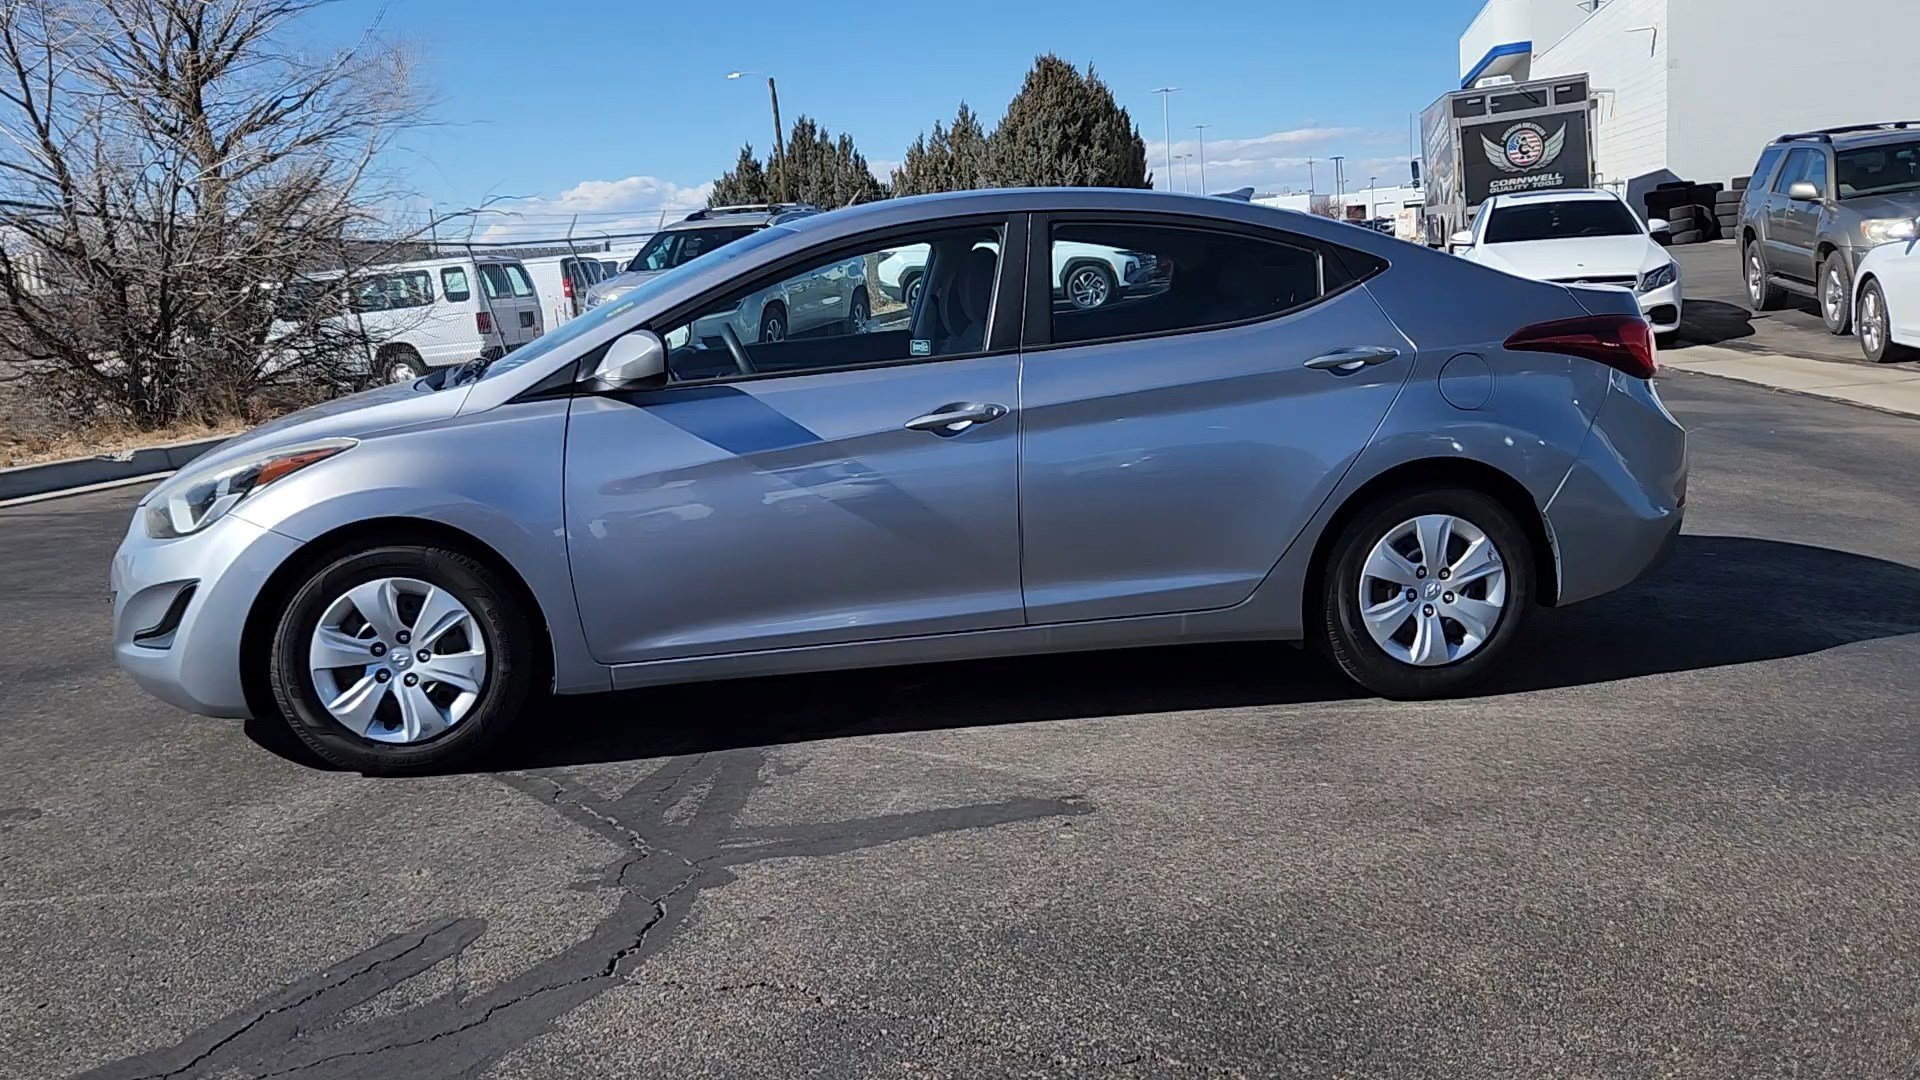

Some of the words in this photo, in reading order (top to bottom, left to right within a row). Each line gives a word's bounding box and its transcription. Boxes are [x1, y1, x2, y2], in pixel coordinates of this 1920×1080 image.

[1489, 172, 1563, 188] CORNWELL
[1489, 183, 1529, 194] QUALITY
[1532, 179, 1563, 188] TOOLS
